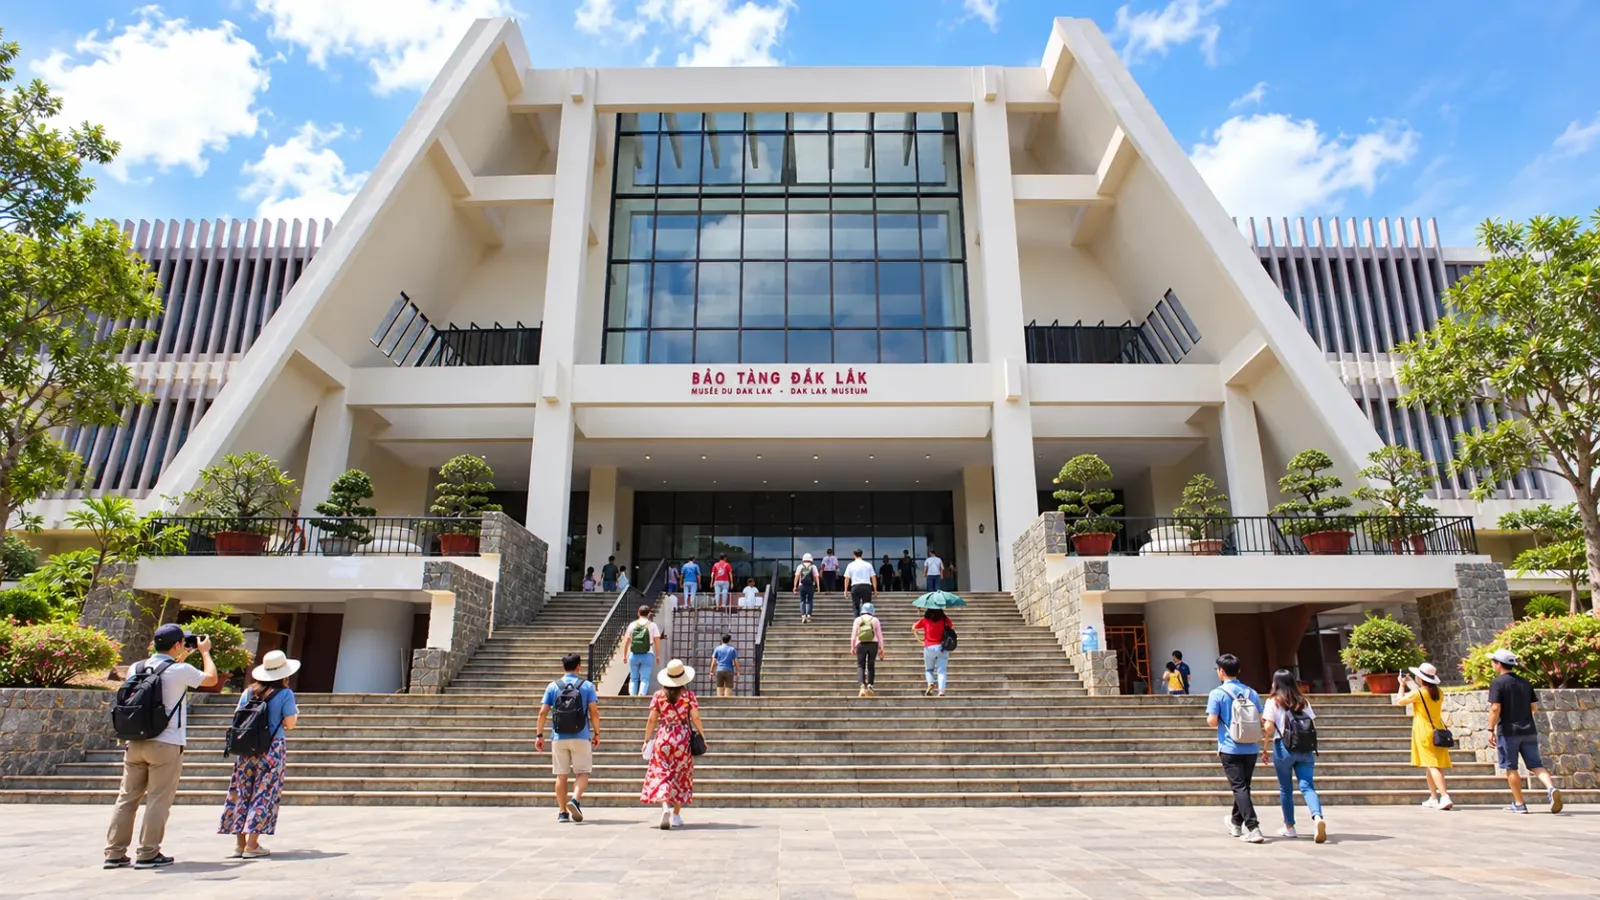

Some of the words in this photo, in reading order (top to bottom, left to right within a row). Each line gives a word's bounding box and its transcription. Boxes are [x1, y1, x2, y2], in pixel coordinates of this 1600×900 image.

[691, 368, 726, 385] BẢO
[737, 368, 780, 385] TÀNG
[691, 387, 718, 395] MUSÉE
